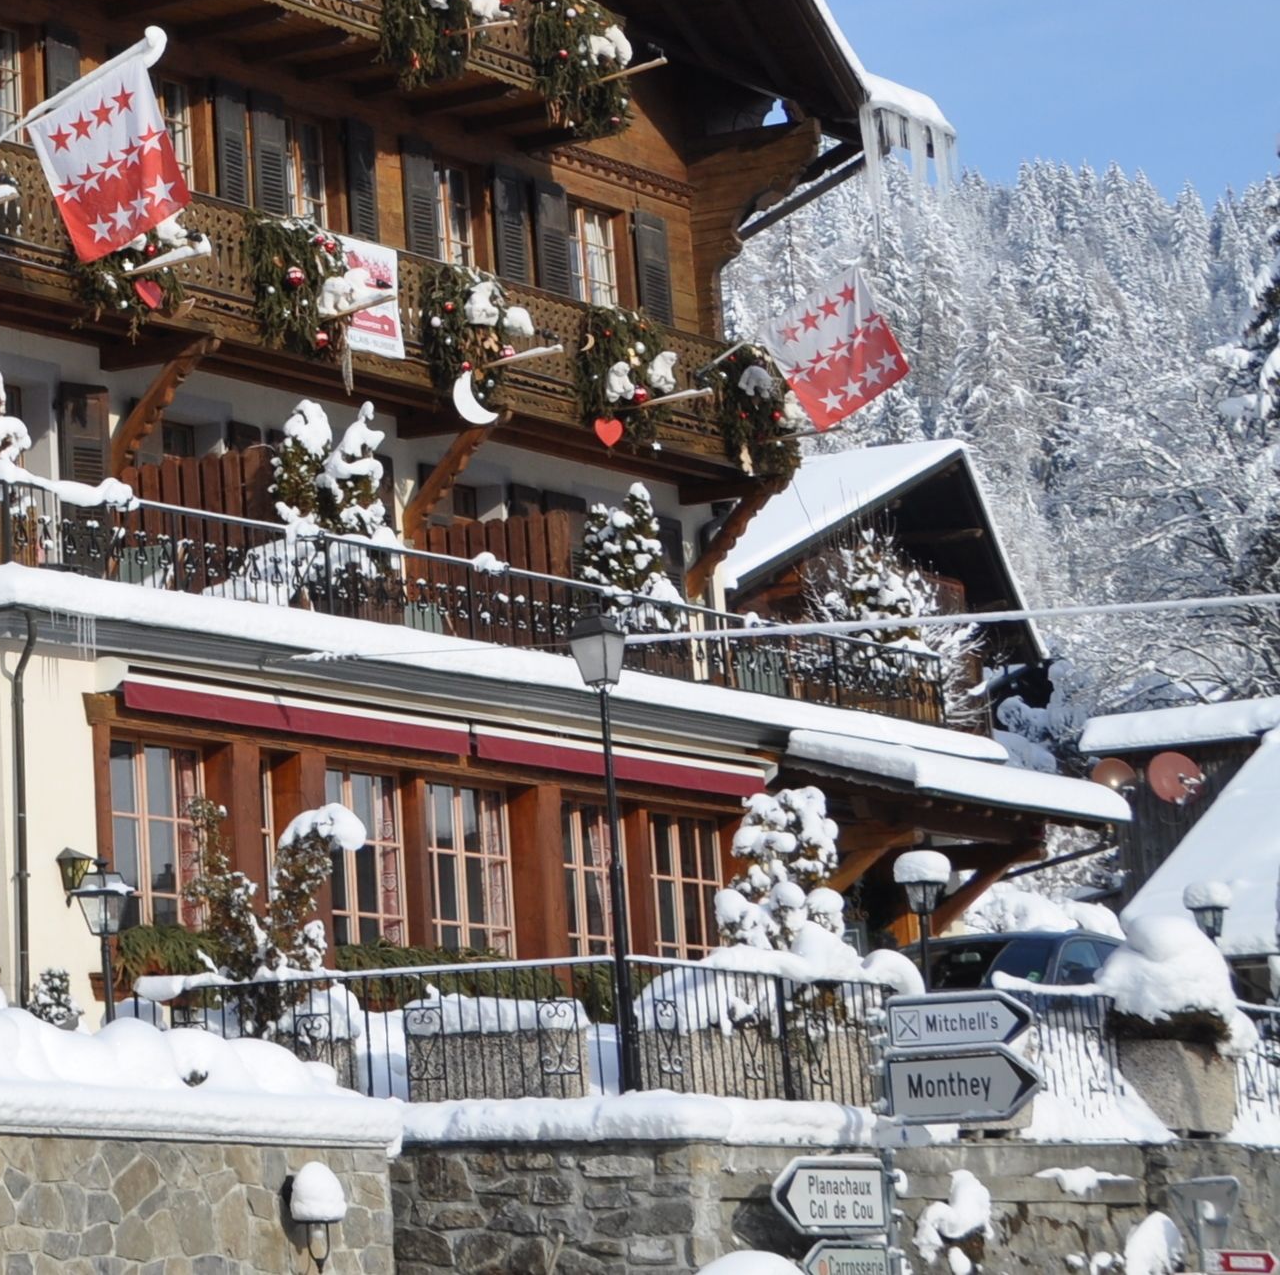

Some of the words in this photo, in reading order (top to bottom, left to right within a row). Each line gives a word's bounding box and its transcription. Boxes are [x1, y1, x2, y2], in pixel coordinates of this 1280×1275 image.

[925, 1011, 999, 1033] Mitchell's
[906, 1071, 992, 1103] Monthey
[807, 1175, 873, 1195] Planachaux
[809, 1200, 828, 1219] Col
[833, 1200, 847, 1219] de
[852, 1200, 874, 1220] Cou
